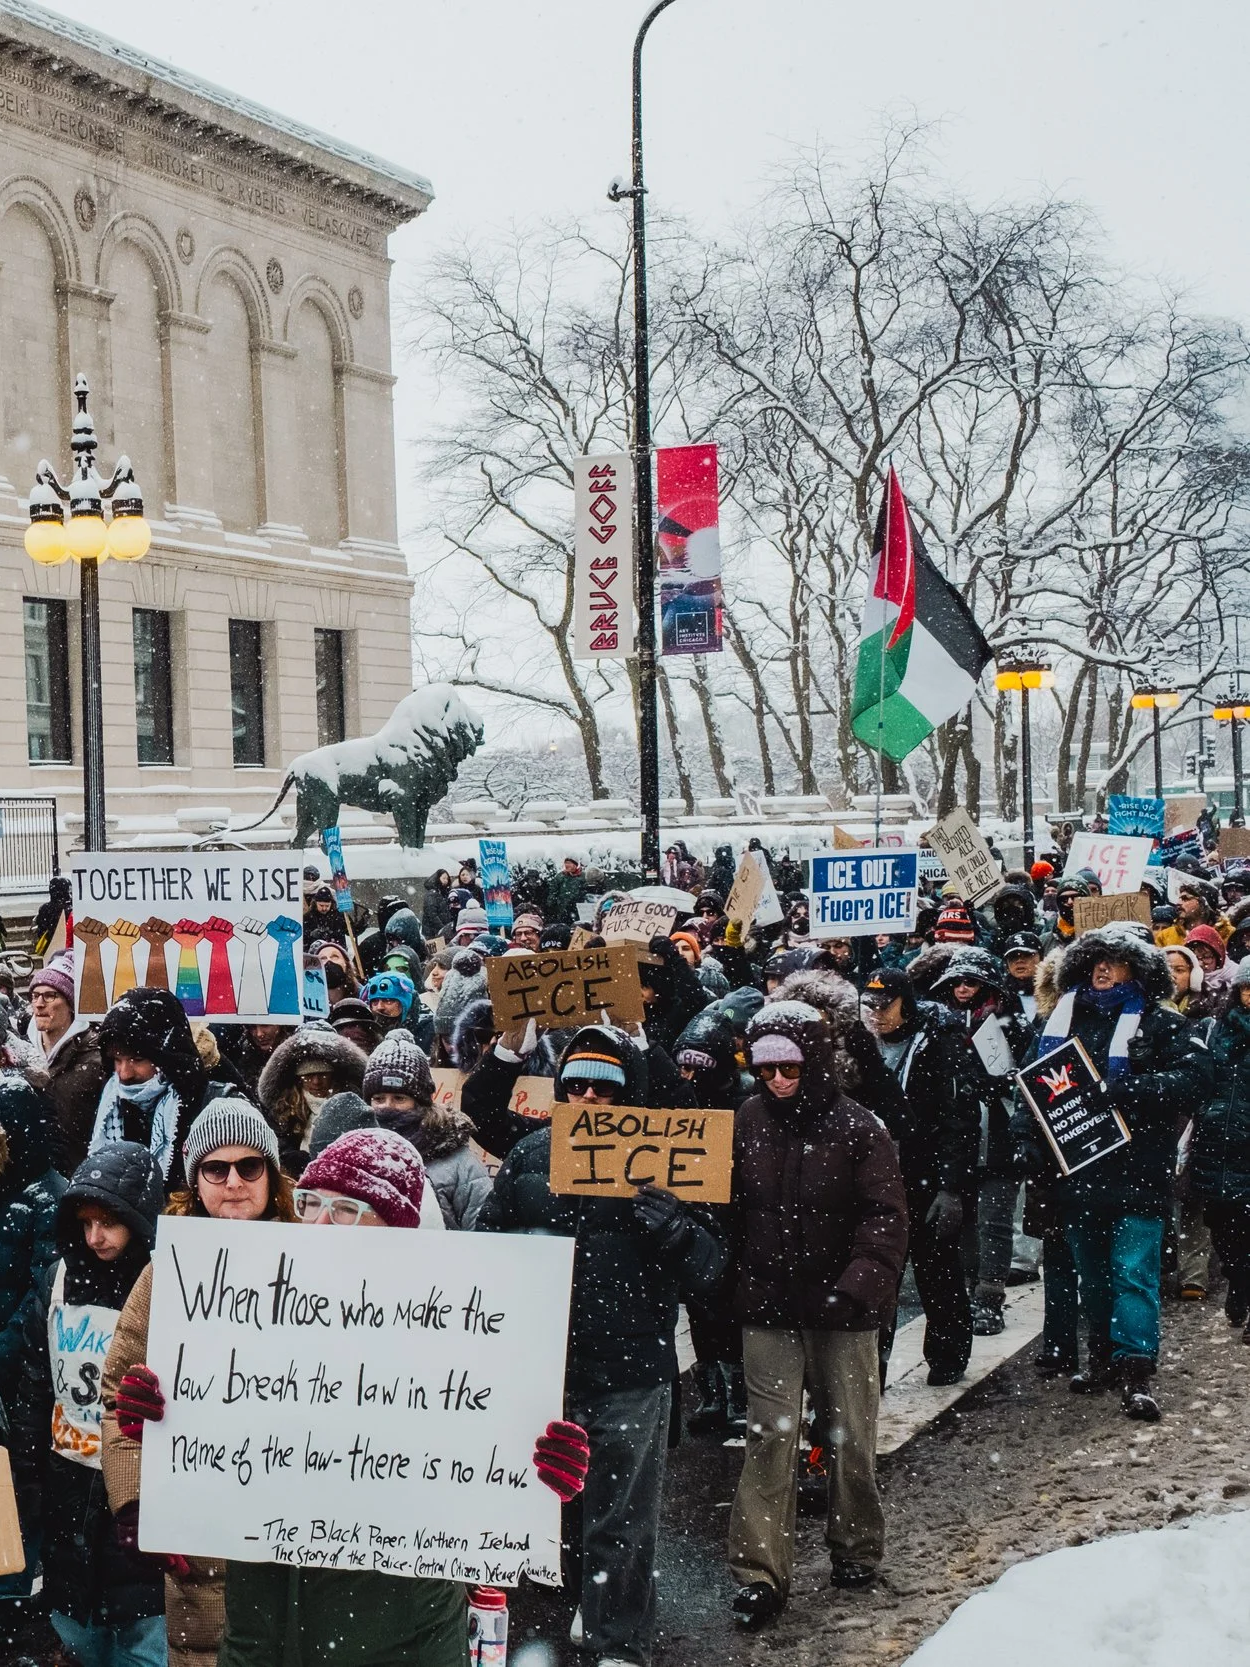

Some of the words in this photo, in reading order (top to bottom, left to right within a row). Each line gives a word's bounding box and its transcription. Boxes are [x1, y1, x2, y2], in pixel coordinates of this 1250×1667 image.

[588, 463, 617, 544] GOFF
[590, 556, 618, 650] BRUCE
[1114, 810, 1138, 818] FIGHT
[1138, 811, 1161, 821] BACK
[1121, 803, 1140, 811] RISE
[958, 838, 976, 858] ALEX
[1088, 844, 1131, 867] ICE
[72, 867, 194, 901] TOGETHER
[204, 867, 232, 902] WE
[242, 867, 300, 902] RISE
[827, 860, 857, 889] ICE
[954, 865, 968, 881] YOU
[1098, 869, 1129, 888] UT
[644, 902, 678, 918] GOOD
[1078, 895, 1142, 930] FUCK
[633, 919, 666, 937] ICE
[503, 953, 611, 982] ABOLISH
[507, 976, 615, 1021] ICE
[1048, 1107, 1064, 1120] NO
[1062, 1095, 1081, 1112] KIN
[1052, 1119, 1068, 1133] NO
[1066, 1107, 1088, 1126] TRU
[569, 1110, 707, 1140] ABOLISH
[571, 1143, 708, 1188] ICE
[170, 1244, 262, 1331] When
[268, 1252, 331, 1329] those
[339, 1279, 384, 1331] who
[461, 1285, 505, 1335] the
[56, 1305, 113, 1355] WAK
[172, 1343, 215, 1401] law
[222, 1347, 299, 1405] break
[307, 1360, 341, 1406] the
[357, 1363, 400, 1408] law
[406, 1376, 428, 1411] in
[439, 1369, 492, 1413] the
[171, 1434, 225, 1475] name
[231, 1436, 253, 1486] of
[261, 1434, 295, 1476] the
[422, 1451, 438, 1481] is
[450, 1453, 475, 1484] no
[310, 1519, 362, 1544] Black
[413, 1526, 469, 1552] Northern
[479, 1530, 531, 1552] Ireland
[271, 1544, 294, 1562] The
[296, 1545, 330, 1568] Story
[328, 1544, 345, 1568] of
[347, 1549, 366, 1567] the
